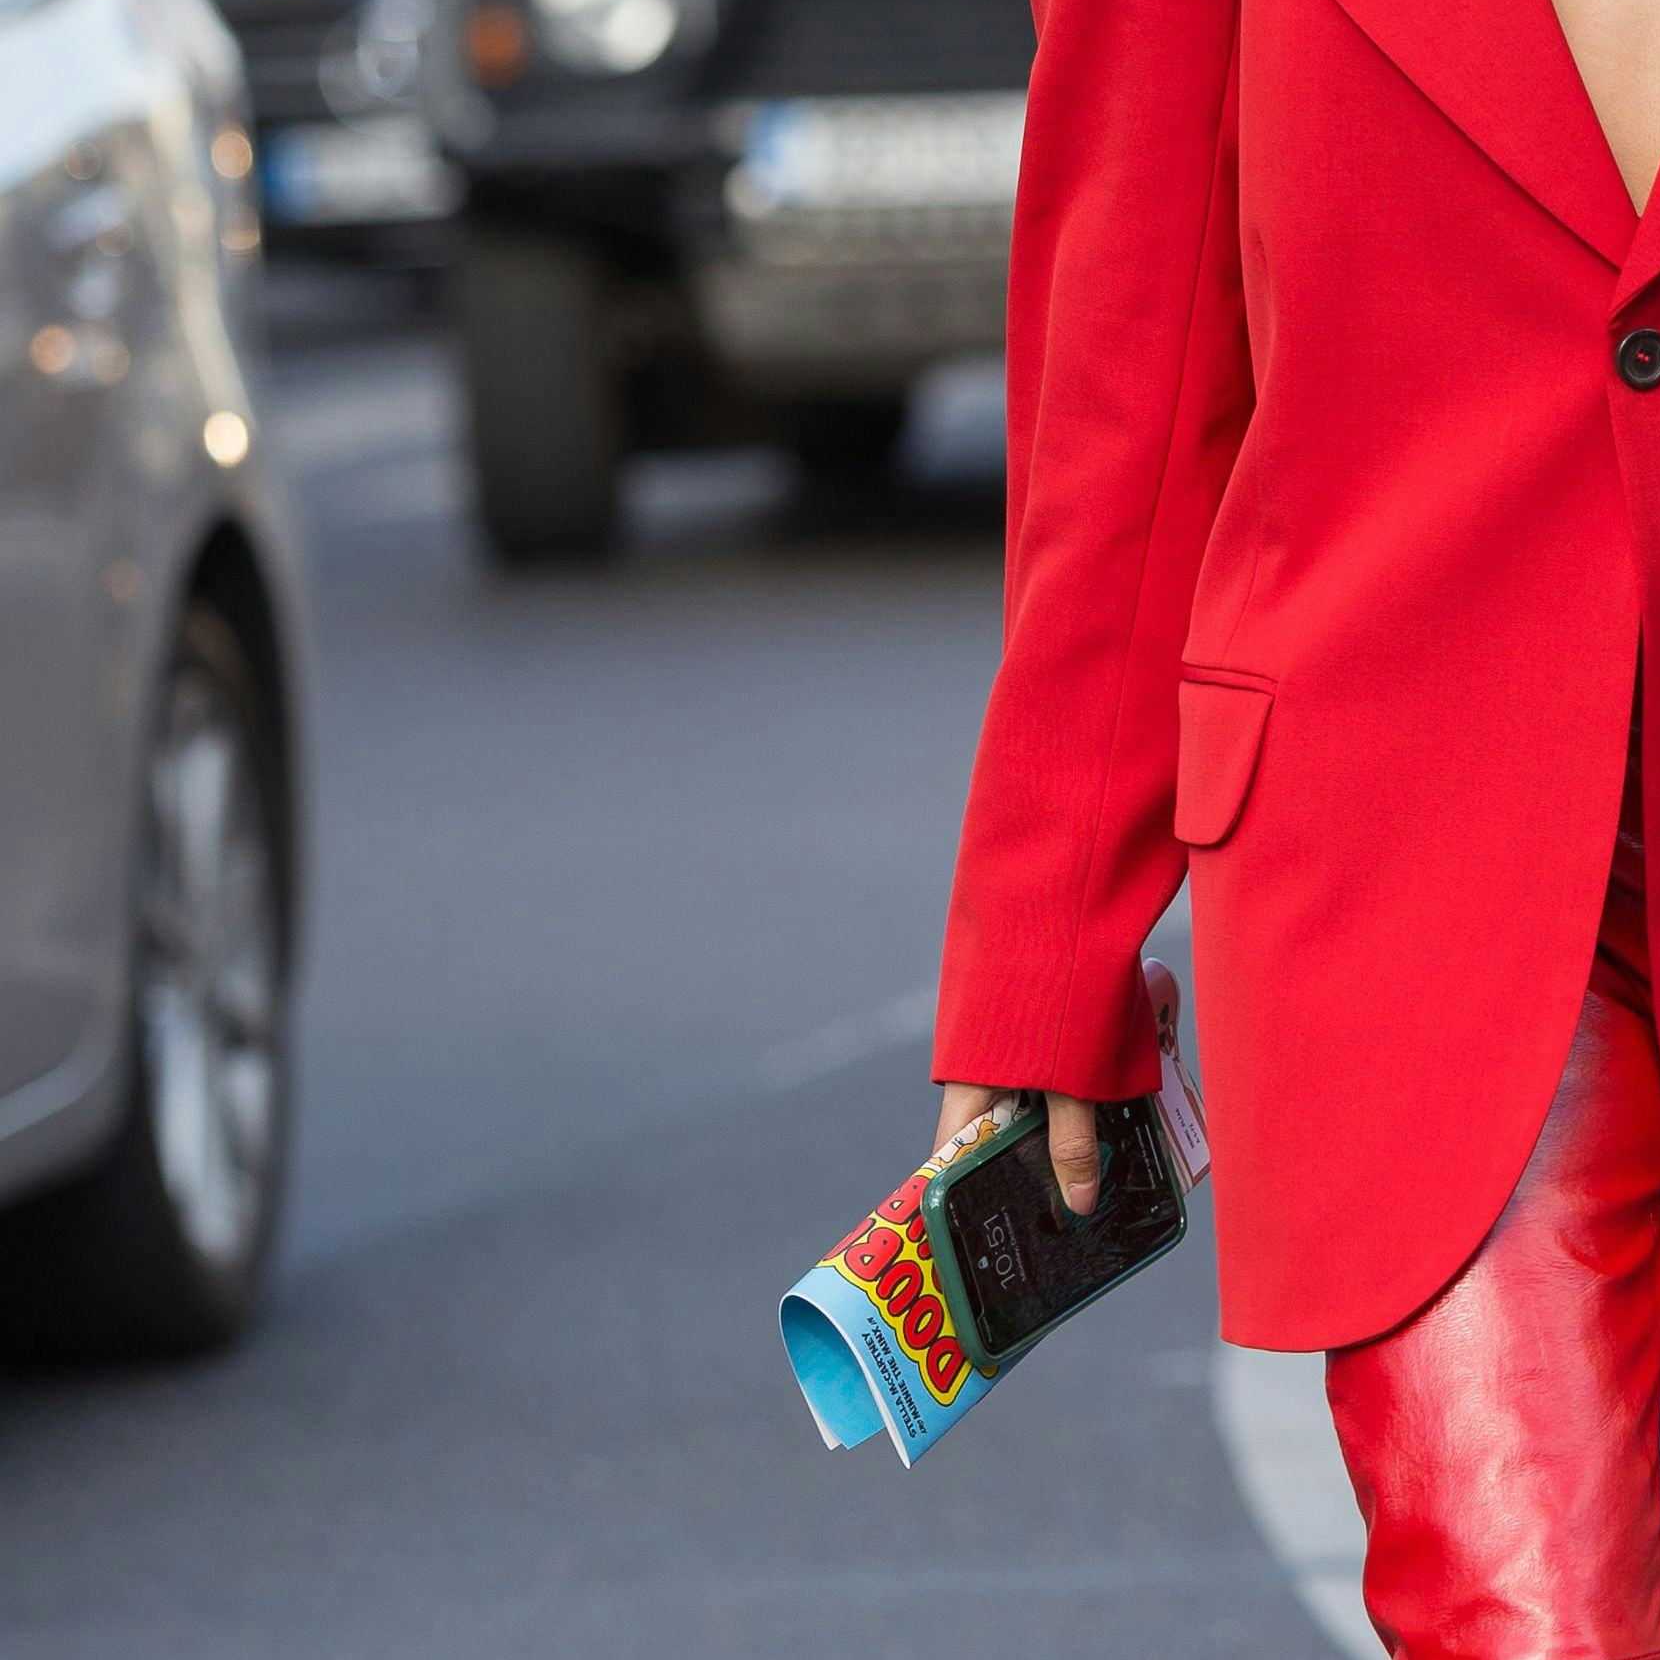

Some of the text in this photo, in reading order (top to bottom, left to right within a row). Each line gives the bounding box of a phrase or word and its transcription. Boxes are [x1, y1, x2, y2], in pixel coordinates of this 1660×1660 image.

[984, 1214, 1015, 1289] 10:51
[872, 1326, 892, 1355] MINX
[862, 1333, 917, 1438] STELLA McCARTNEY
[887, 1356, 902, 1380] THE
[898, 1380, 920, 1419] MINNIE
